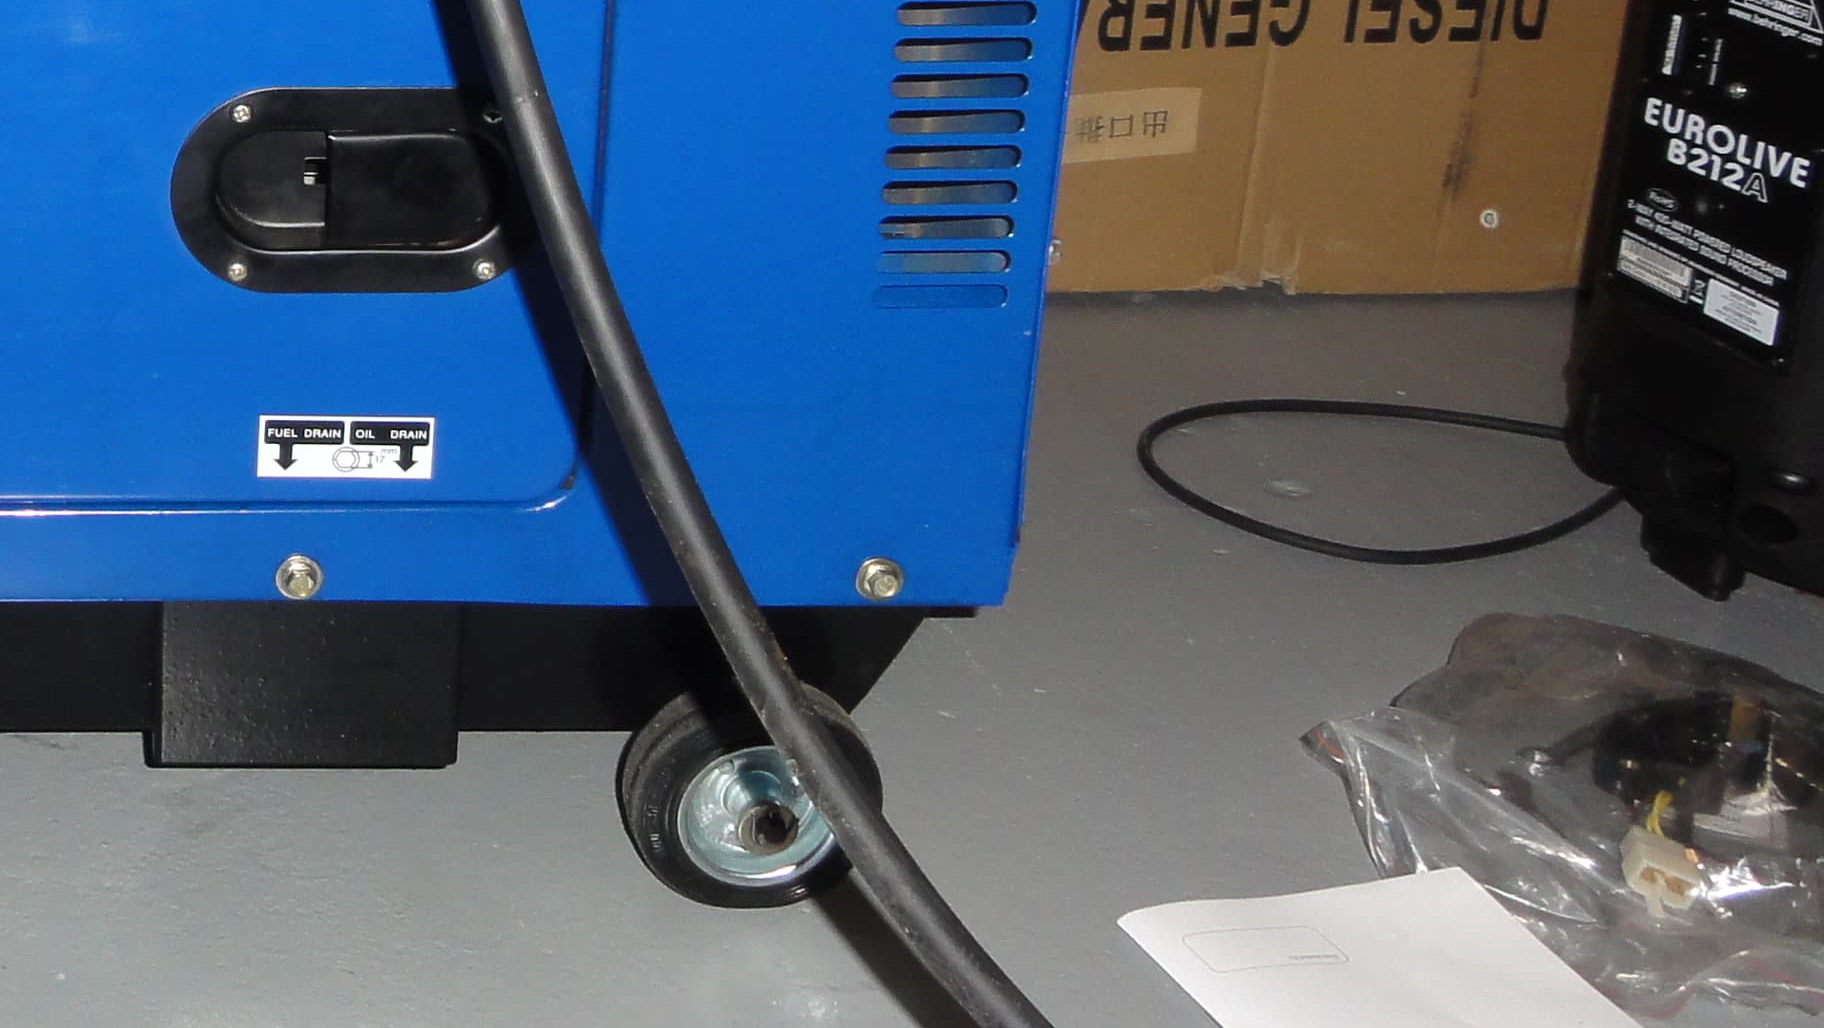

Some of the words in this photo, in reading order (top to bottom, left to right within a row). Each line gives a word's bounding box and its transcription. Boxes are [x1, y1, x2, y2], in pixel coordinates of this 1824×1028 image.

[1643, 97, 1811, 189] EUROLIVE
[1666, 137, 1769, 204] B212A
[267, 428, 299, 439] FUEL
[304, 428, 342, 439] DRAIN
[355, 429, 376, 439] OIL
[390, 430, 428, 440] DRAIN
